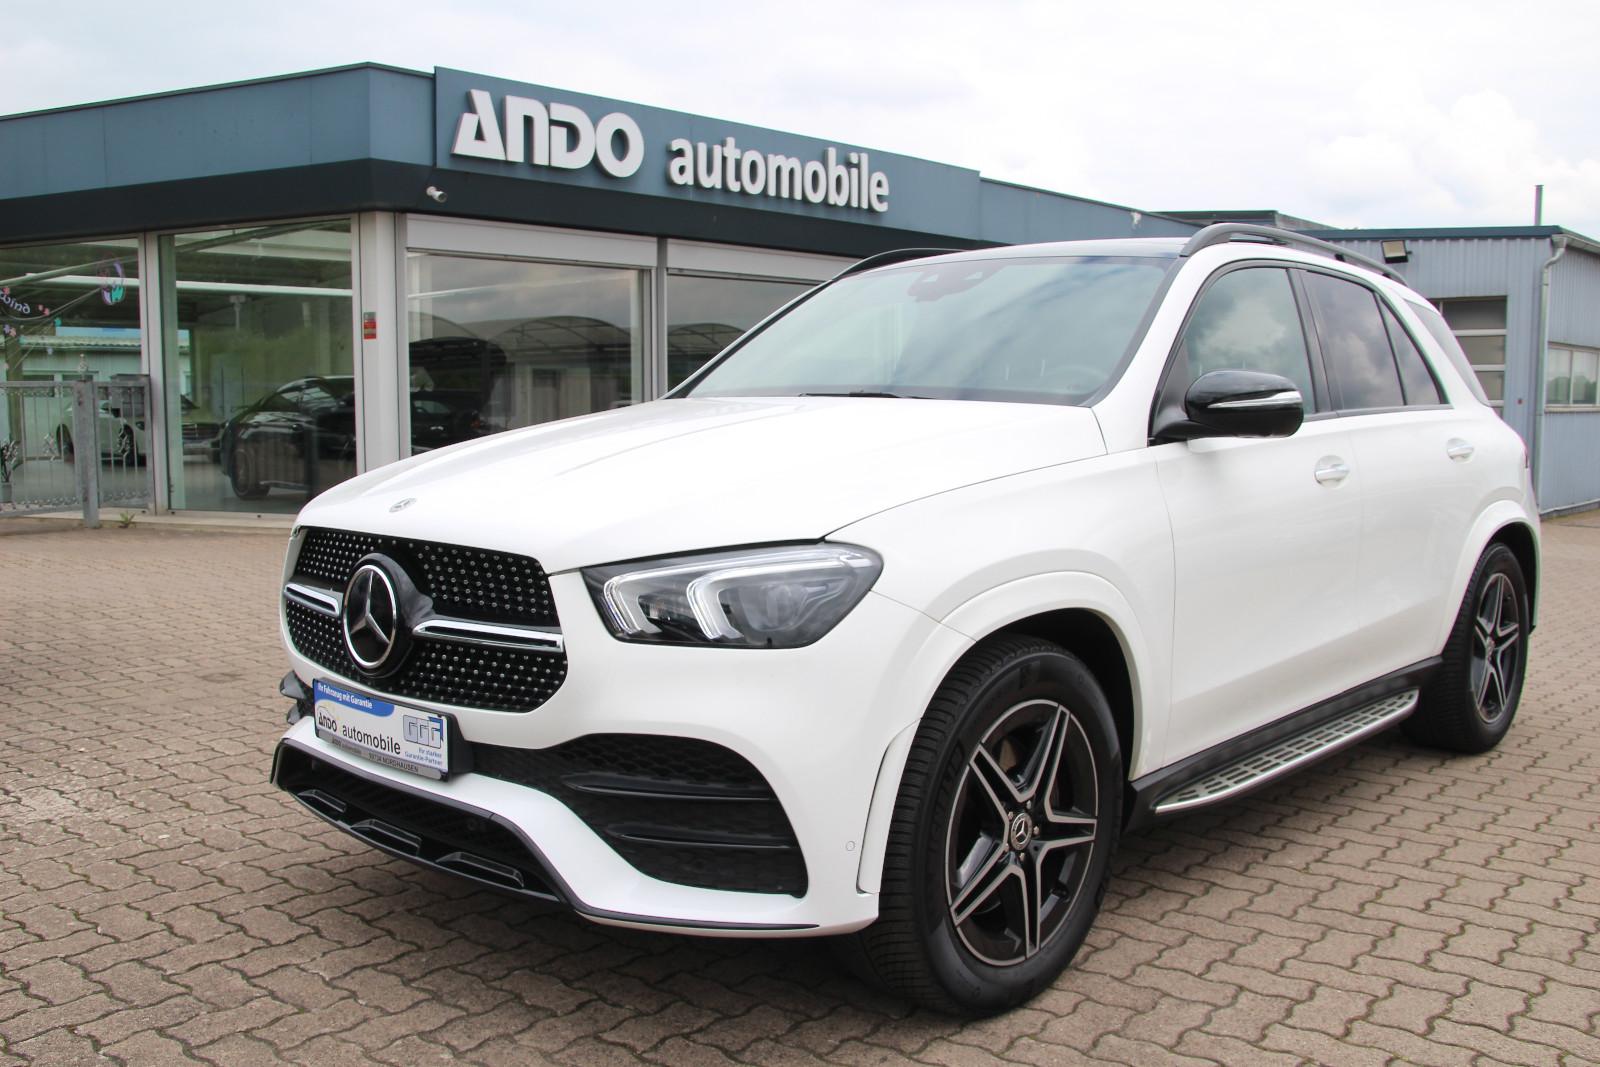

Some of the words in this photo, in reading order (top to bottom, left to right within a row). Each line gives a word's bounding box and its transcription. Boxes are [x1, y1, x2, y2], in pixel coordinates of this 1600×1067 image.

[450, 88, 645, 178] ANDO
[667, 137, 889, 213] automobile
[324, 684, 342, 702] Fahrzeug
[342, 692, 351, 703] mit
[351, 695, 373, 709] Garantie
[318, 712, 337, 733] ANDO
[342, 724, 401, 755] automobile
